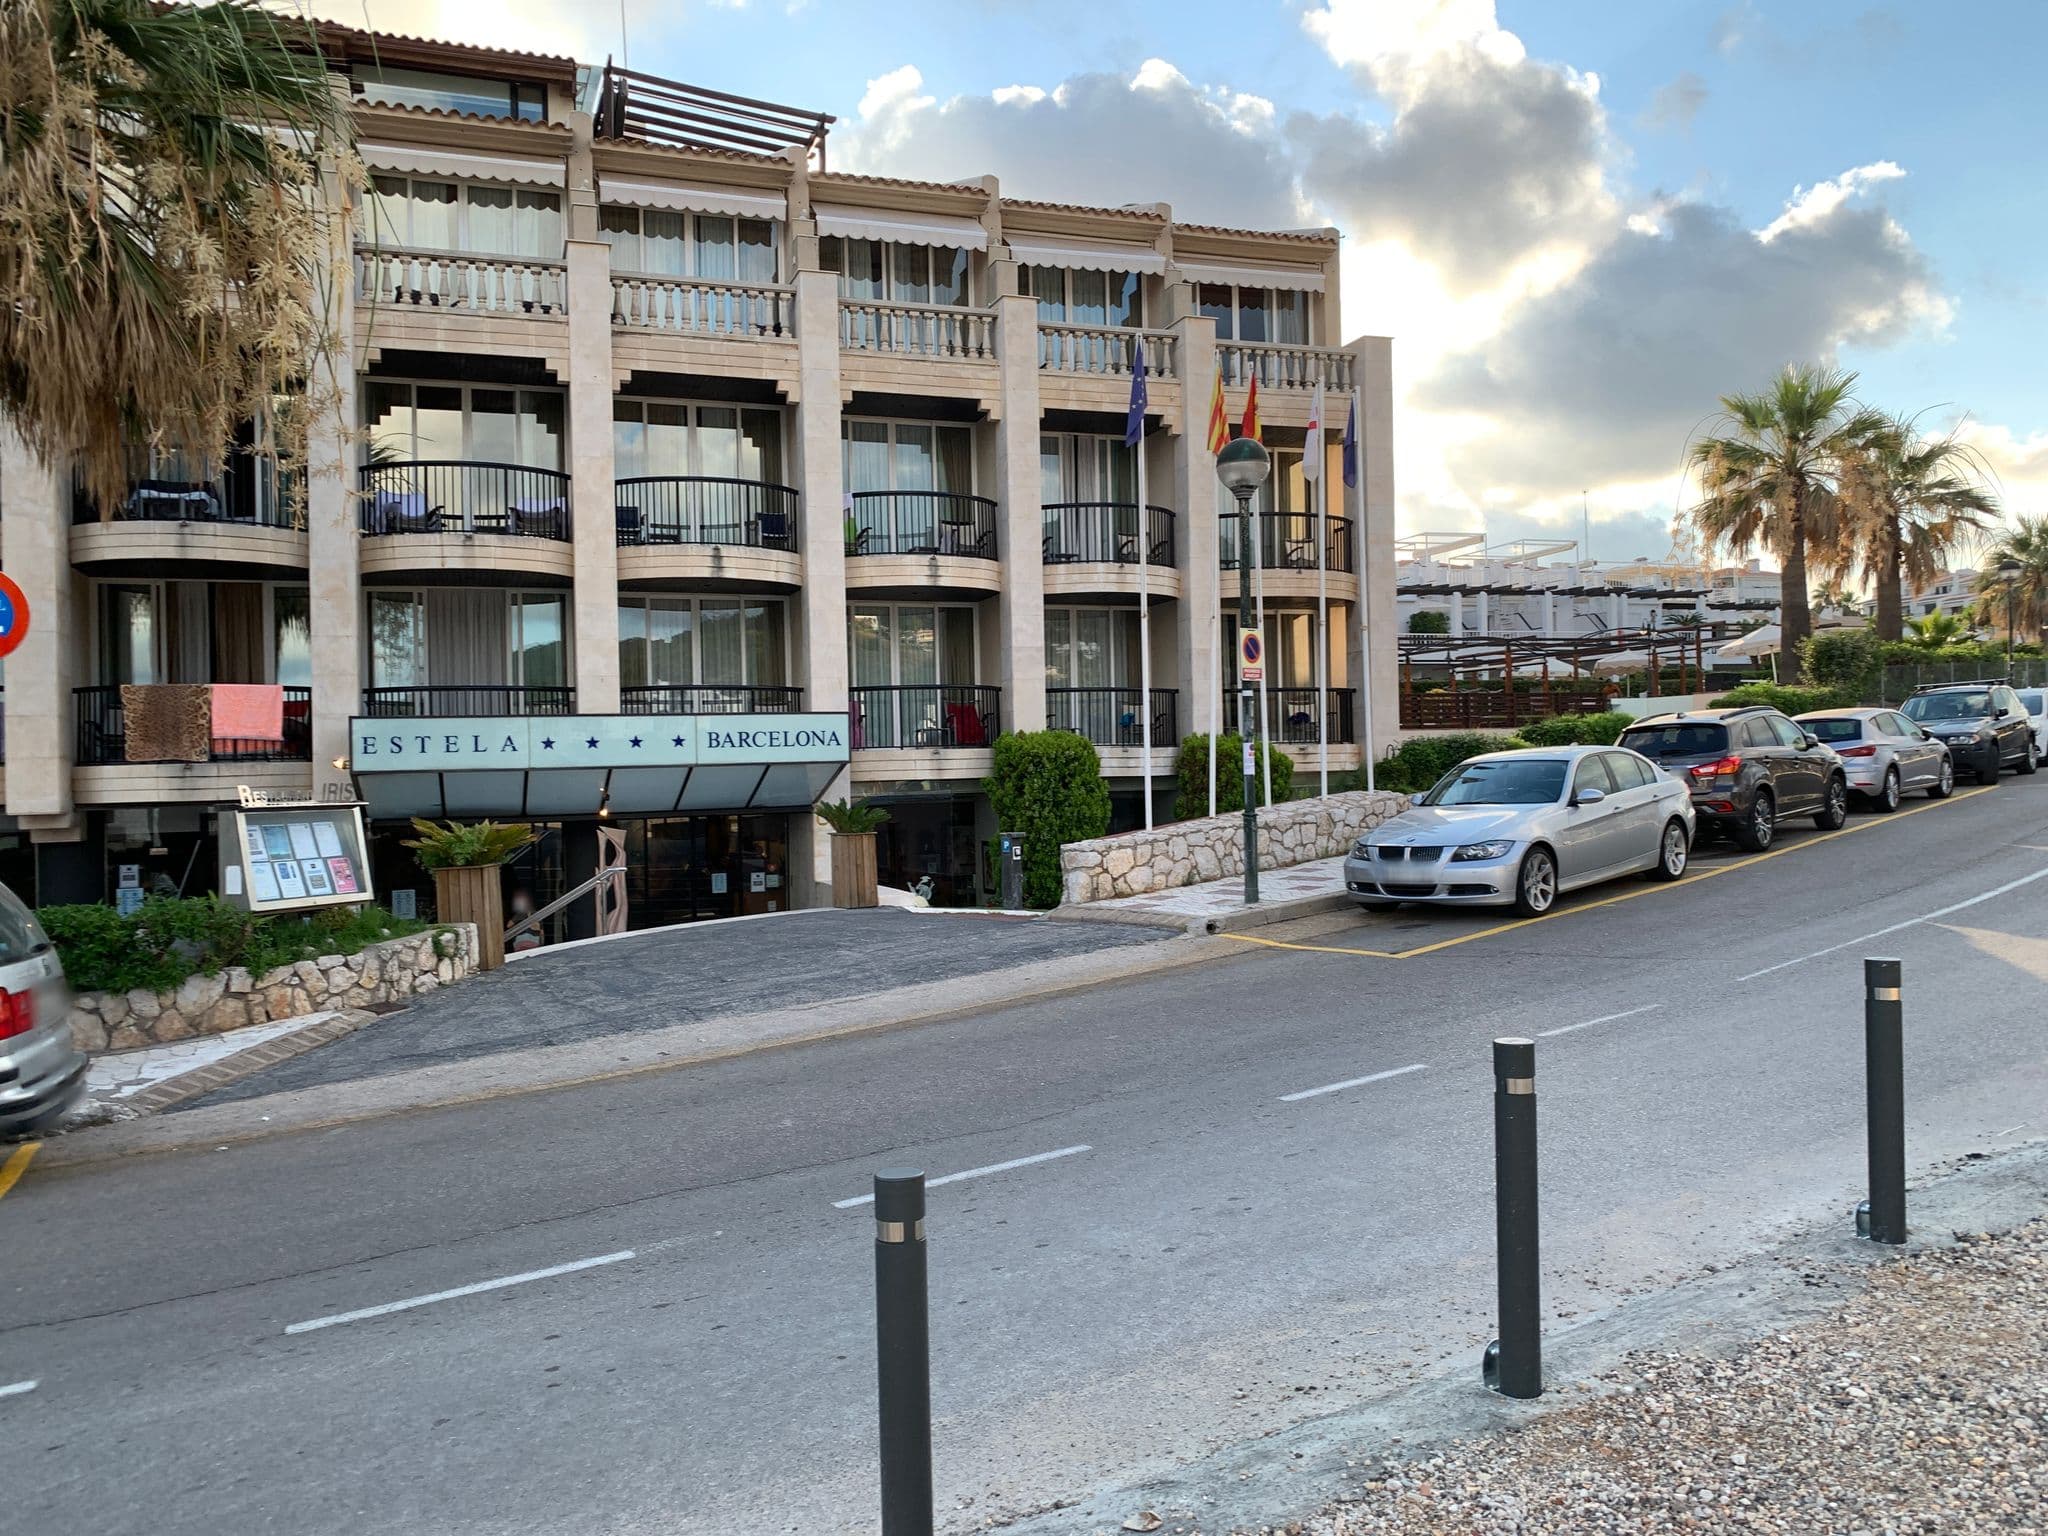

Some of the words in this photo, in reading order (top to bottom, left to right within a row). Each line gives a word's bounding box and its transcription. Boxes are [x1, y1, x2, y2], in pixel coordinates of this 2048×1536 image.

[361, 735, 519, 755] ESTELA
[707, 730, 842, 749] BARCELONA
[322, 782, 354, 801] IRIS
